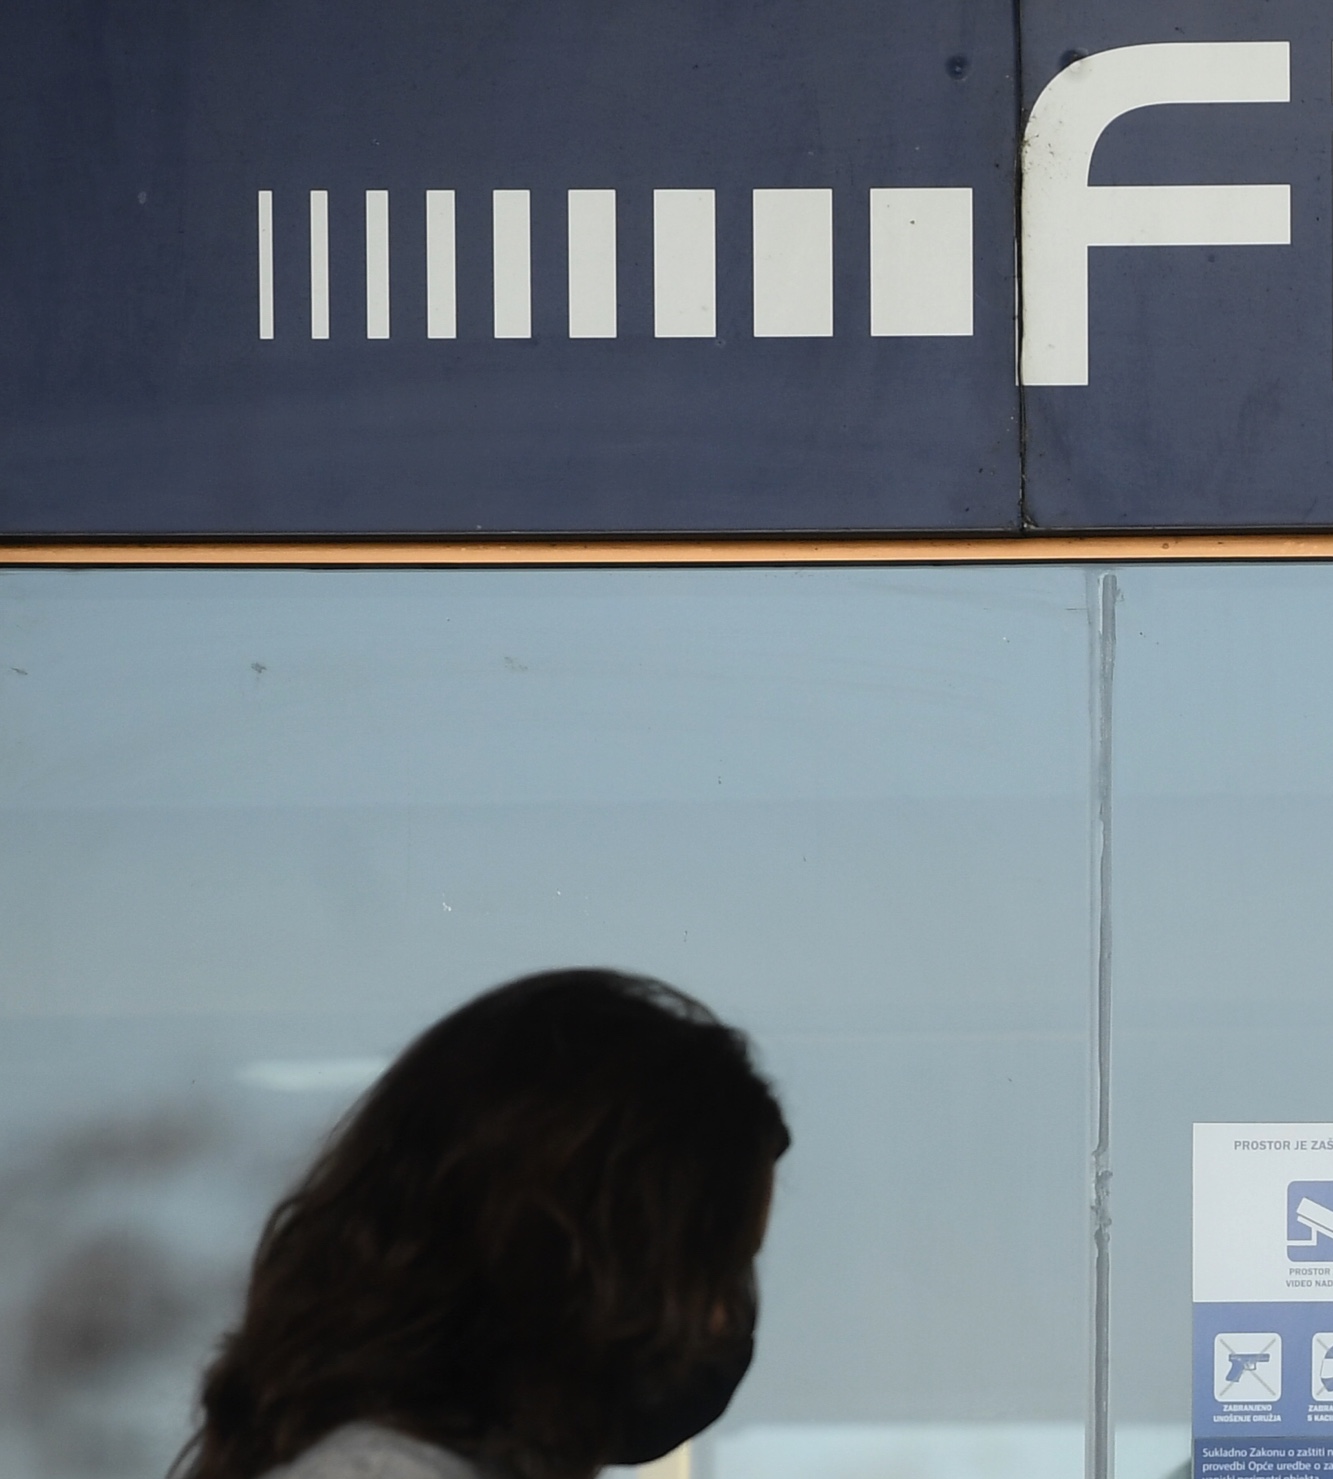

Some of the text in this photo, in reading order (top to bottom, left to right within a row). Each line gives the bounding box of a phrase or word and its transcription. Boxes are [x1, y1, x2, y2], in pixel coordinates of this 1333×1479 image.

[1234, 1140, 1290, 1150] PROSTOR
[1294, 1140, 1307, 1150] JE
[1288, 1267, 1330, 1275] PROSTOR
[1285, 1279, 1312, 1287] VIDEO
[1202, 1447, 1247, 1457] Sukladno
[1249, 1446, 1285, 1457] Zakonu
[1287, 1449, 1294, 1457] o
[1296, 1447, 1325, 1457] zaštiti
[1202, 1460, 1245, 1473] provedbi
[1247, 1460, 1274, 1472] Opće
[1276, 1460, 1311, 1470] uredbe
[1313, 1462, 1321, 1470] o
